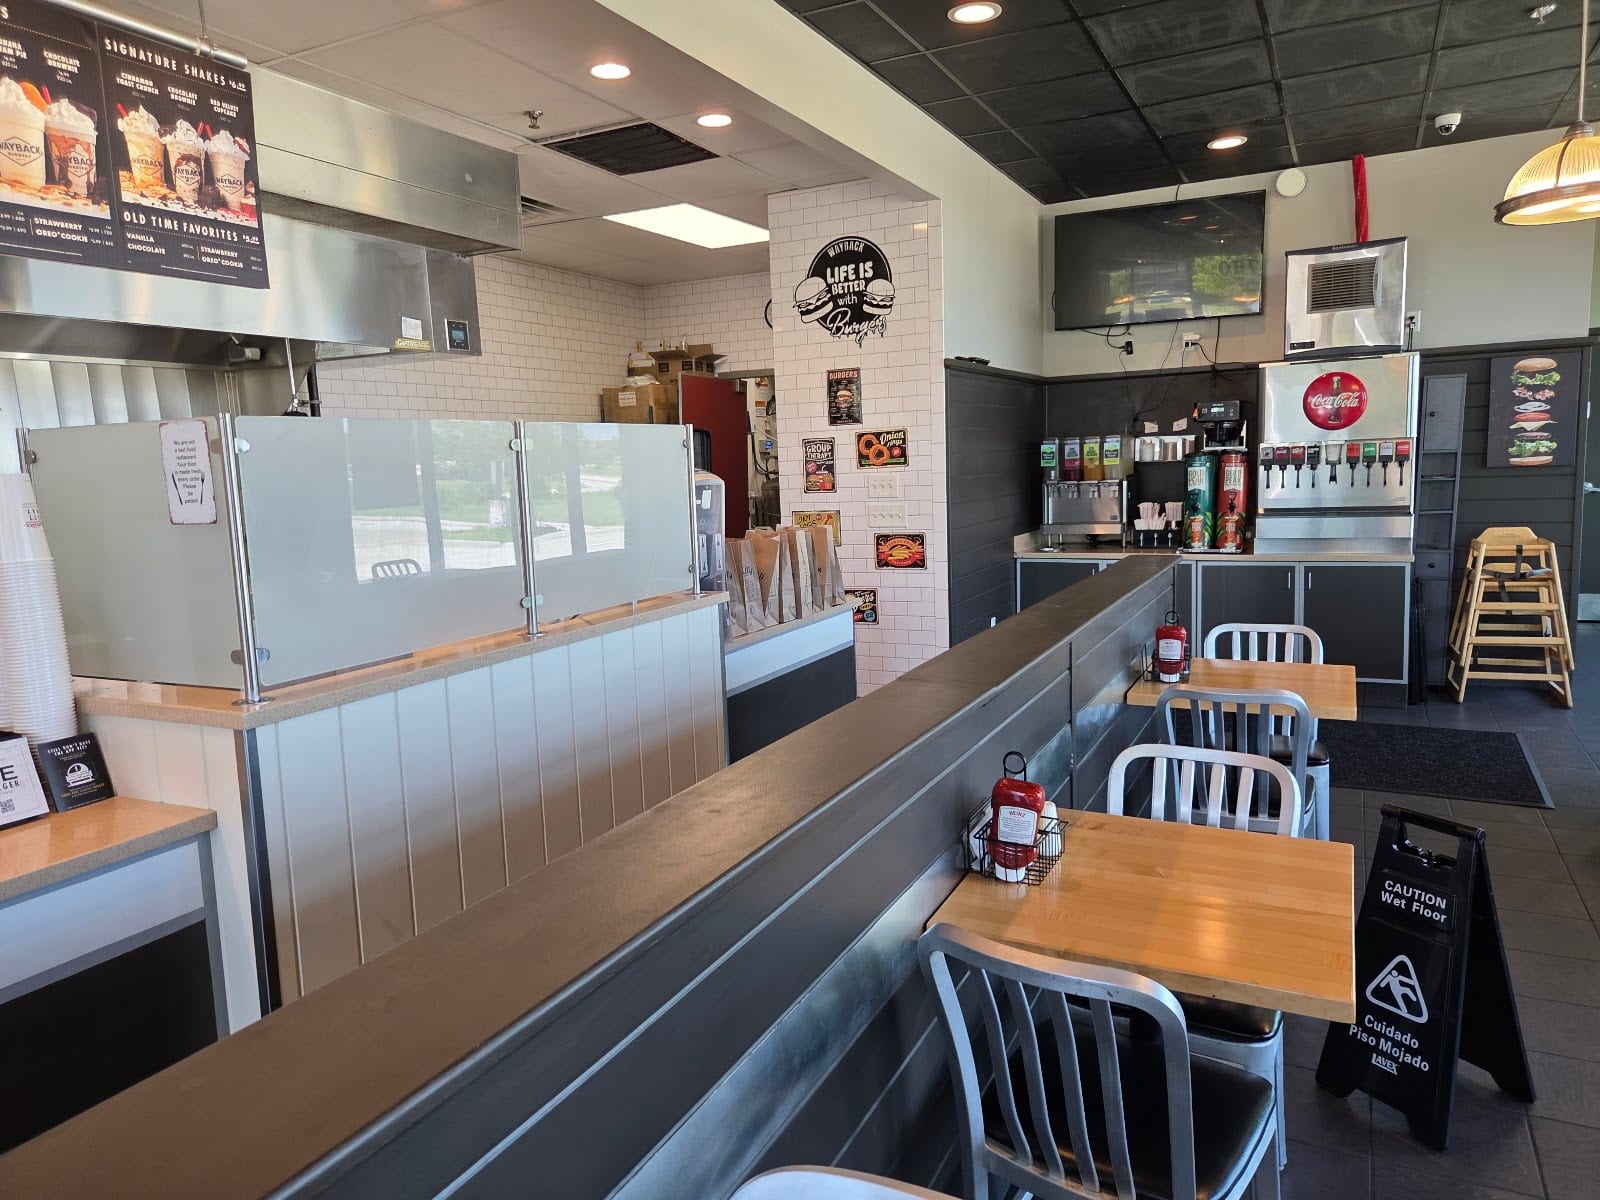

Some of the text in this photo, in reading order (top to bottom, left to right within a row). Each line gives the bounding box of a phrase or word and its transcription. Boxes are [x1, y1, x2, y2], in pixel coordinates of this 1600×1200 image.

[43, 49, 80, 67] CHOCOLATE
[47, 58, 79, 73] BROWNIE
[104, 38, 177, 70] SIGNATURE
[184, 64, 226, 86] SHAKES
[116, 77, 135, 89] TOAST
[136, 83, 159, 95] CRUNCH
[120, 72, 153, 87] CINNAMON
[167, 86, 198, 100] CHOCOLATE
[170, 93, 197, 106] BROWNIE
[213, 106, 237, 118] CUPCAKE
[34, 217, 83, 231] STRAWBERRY
[123, 211, 146, 225] OLD
[151, 215, 179, 231] TIME
[183, 222, 238, 242] FAVORITES
[61, 232, 89, 243] COOKIE
[126, 232, 155, 243] VANILLA
[127, 243, 166, 255] CHOCOLATE
[200, 246, 239, 258] STRAWBERRY
[827, 241, 865, 258] WAYBACK
[221, 259, 244, 269] COOKIE
[826, 261, 874, 284] LIFE IS
[832, 280, 866, 296] BETTER
[838, 294, 858, 306] with
[827, 307, 888, 344] Burgers
[829, 370, 859, 380] BURGERS
[880, 431, 905, 445] Onion
[806, 443, 832, 453] GROUP
[806, 452, 832, 460] THERAPY
[1384, 880, 1447, 909] CAUTION
[1381, 890, 1447, 923] Wet Floor
[1364, 1014, 1420, 1049] Cuidado
[1349, 1023, 1430, 1072] Piso Mojado
[1371, 1053, 1399, 1076] LAVEX
